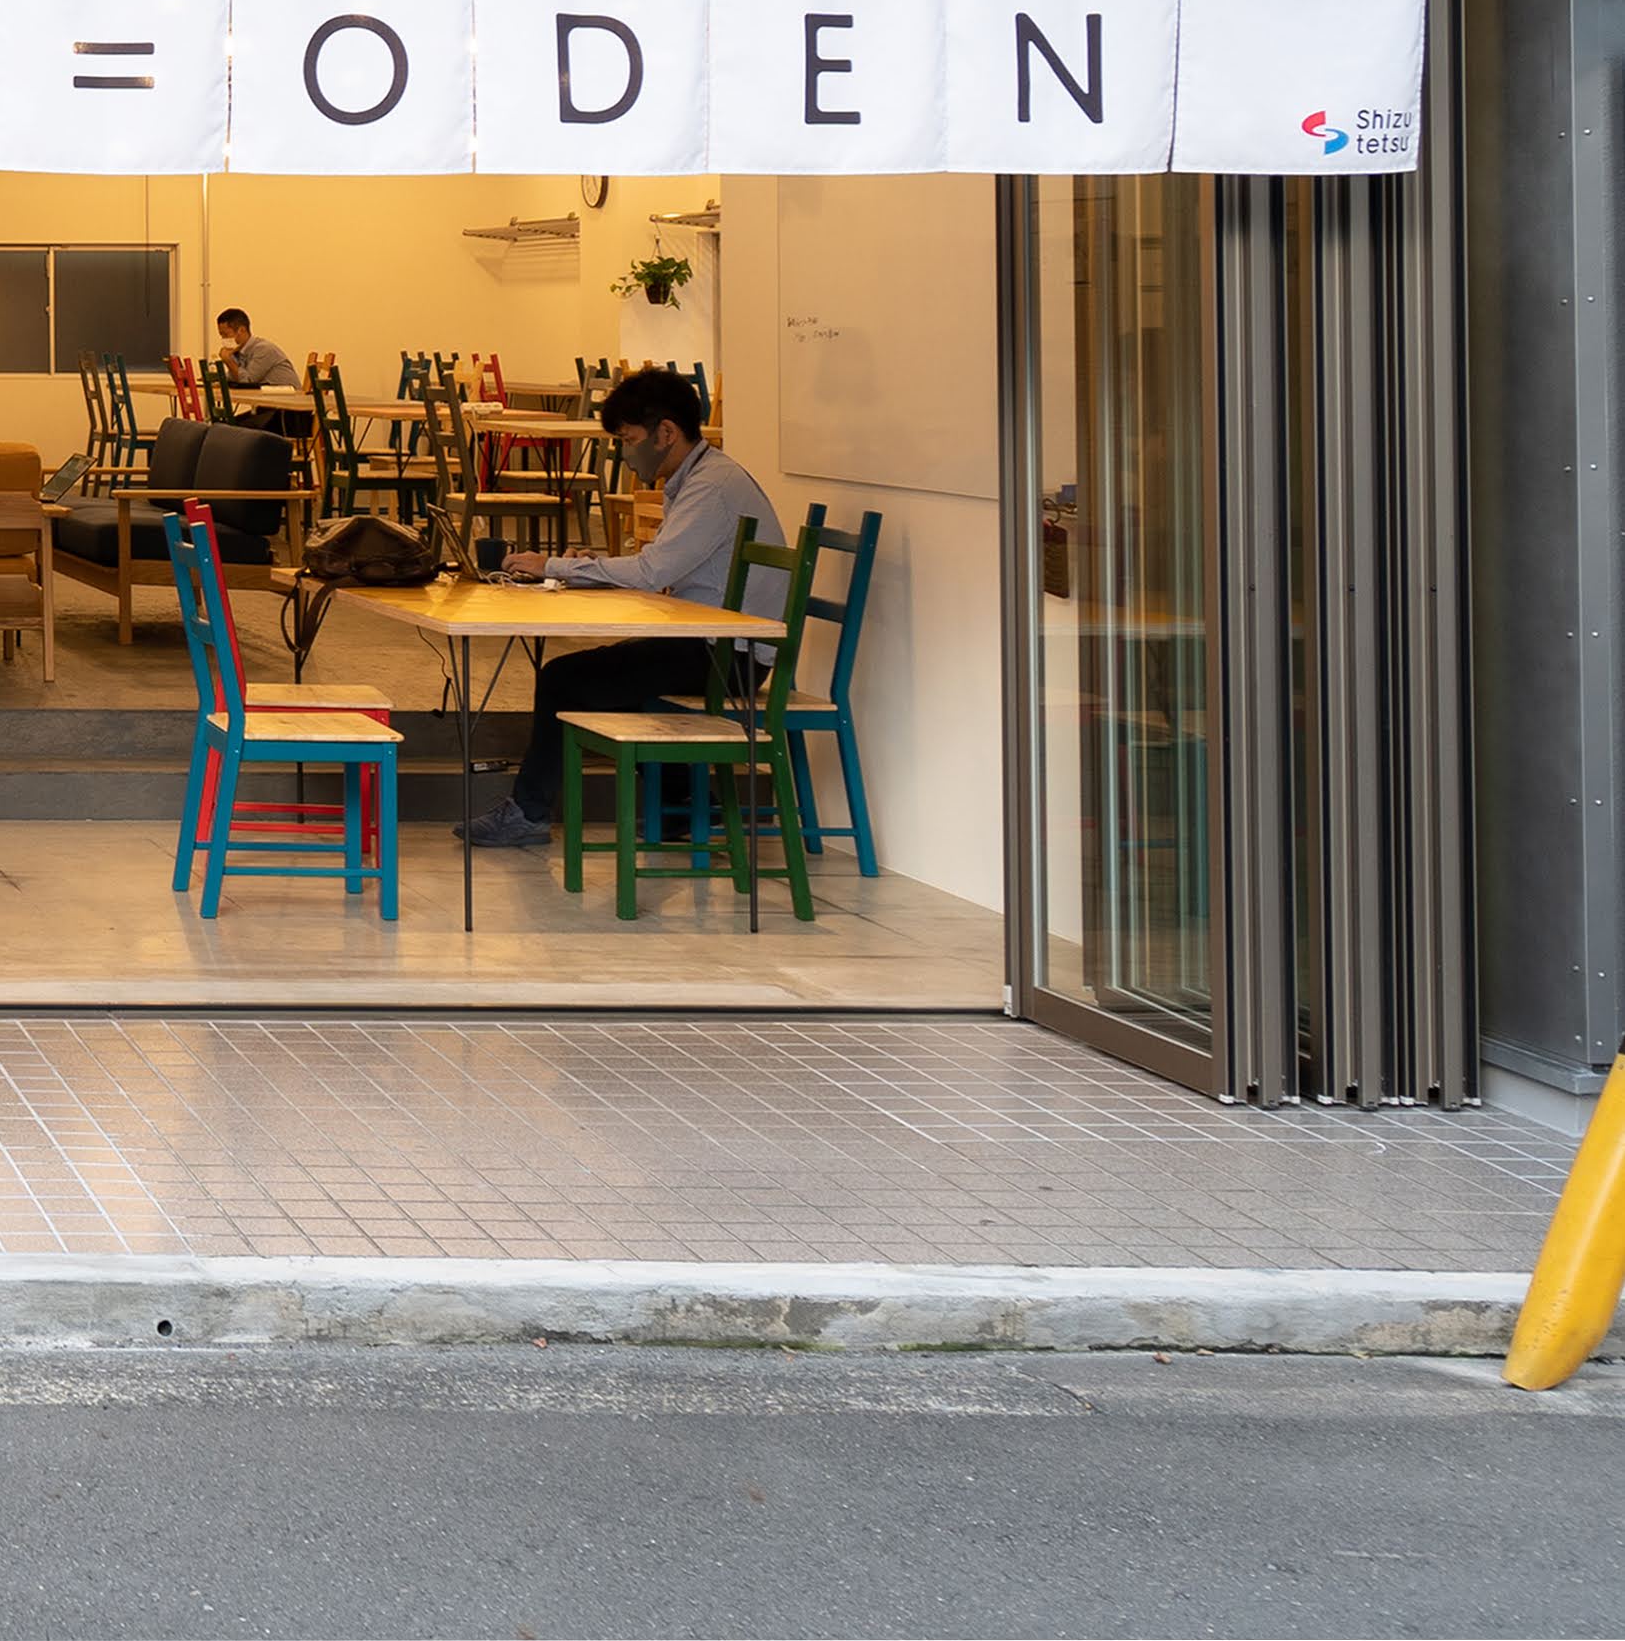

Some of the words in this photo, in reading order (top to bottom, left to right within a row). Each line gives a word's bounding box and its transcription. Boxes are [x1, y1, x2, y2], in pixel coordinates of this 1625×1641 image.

[303, 12, 1103, 126] ODEN
[1356, 109, 1412, 130] Shizu
[1356, 133, 1409, 154] tetsu
